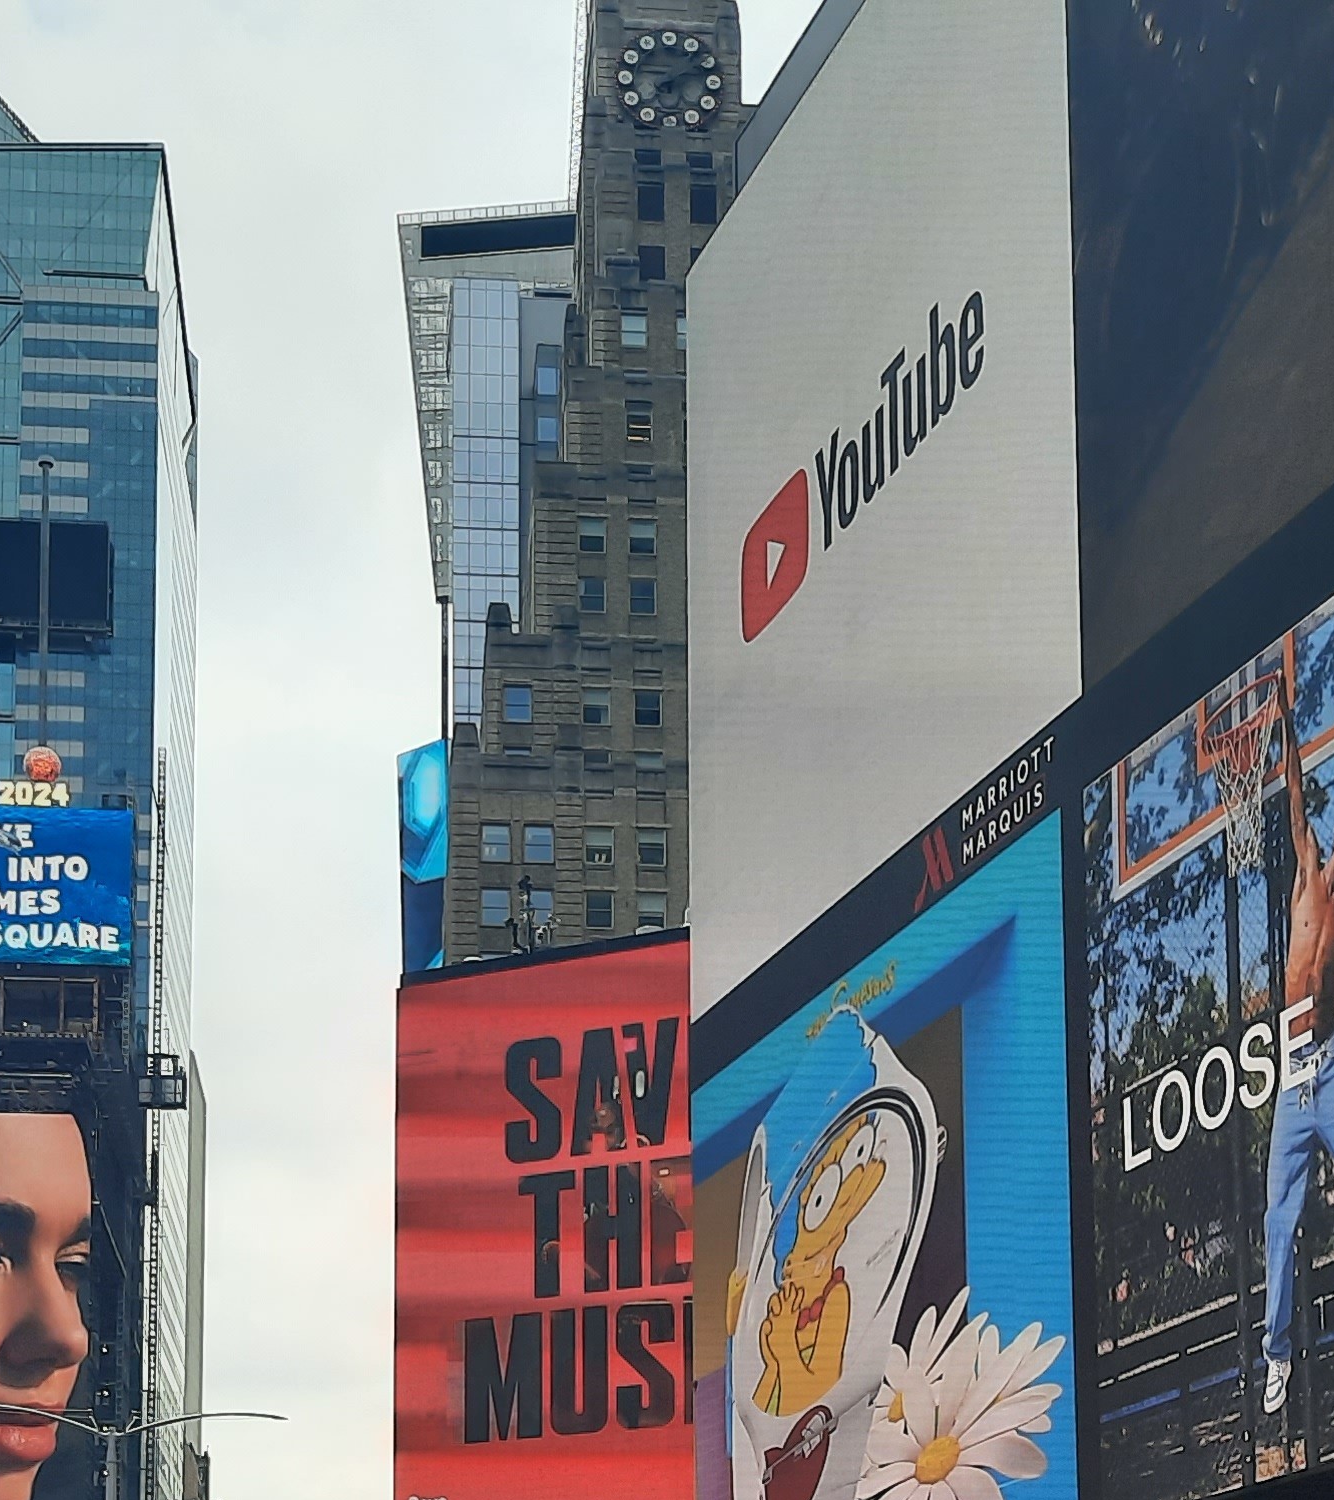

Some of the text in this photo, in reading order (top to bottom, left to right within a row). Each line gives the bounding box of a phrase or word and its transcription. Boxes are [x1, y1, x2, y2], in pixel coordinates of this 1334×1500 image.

[814, 290, 986, 552] YouTube
[961, 735, 1054, 831] MARRIOTT
[962, 782, 1044, 865] MARQUIS
[8, 856, 88, 882] INTO
[505, 1016, 692, 1164] SAV
[1121, 994, 1319, 1173] LOOSE
[463, 1302, 694, 1444] MUS
